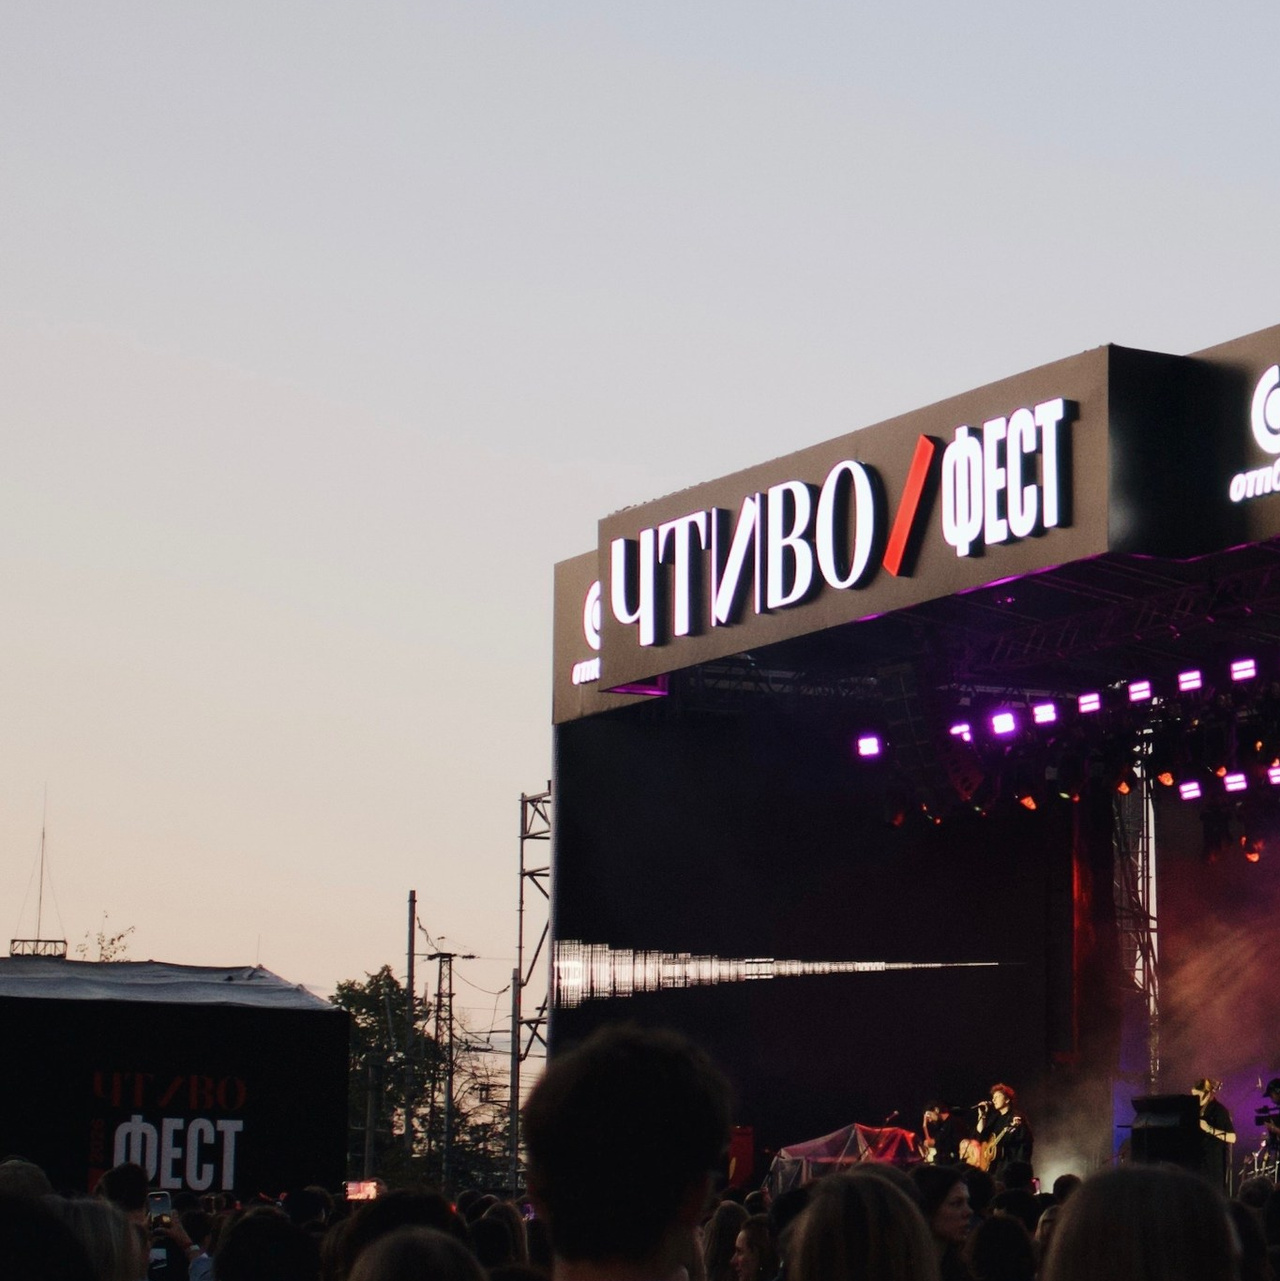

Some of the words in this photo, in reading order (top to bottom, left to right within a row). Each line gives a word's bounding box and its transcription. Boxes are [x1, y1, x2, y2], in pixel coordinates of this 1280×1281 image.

[611, 459, 874, 646] ЧТИВО
[941, 397, 1065, 557] ФЕСТ
[113, 1114, 244, 1191] ФЕСТ
